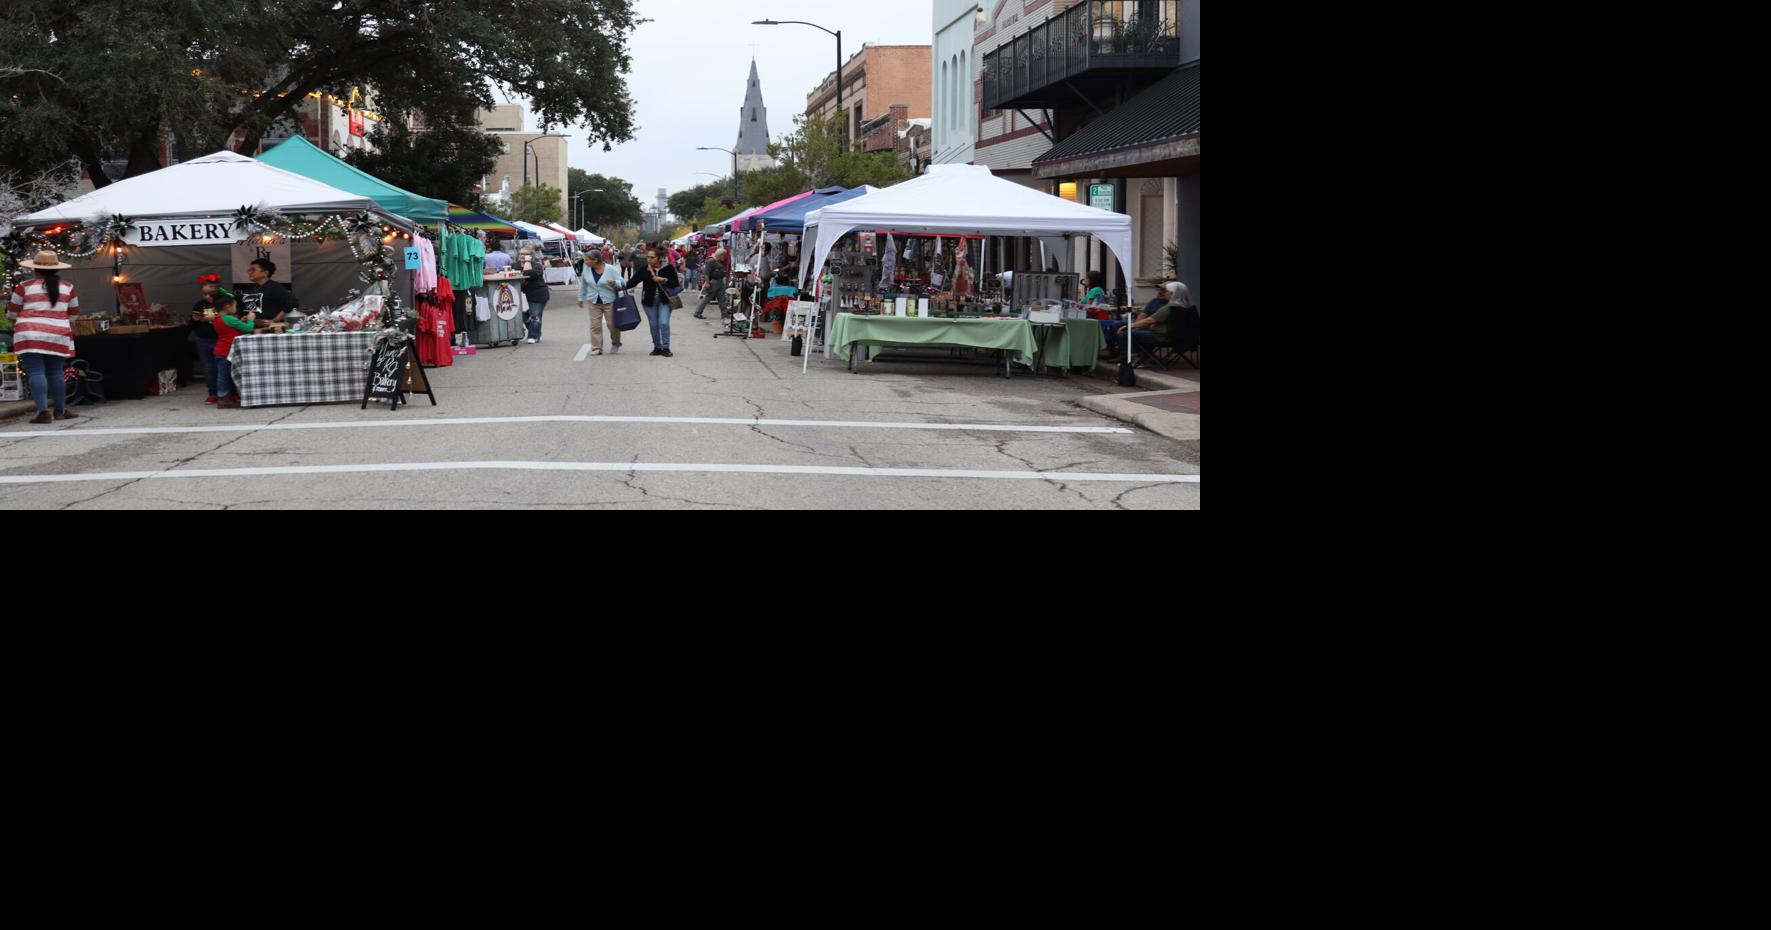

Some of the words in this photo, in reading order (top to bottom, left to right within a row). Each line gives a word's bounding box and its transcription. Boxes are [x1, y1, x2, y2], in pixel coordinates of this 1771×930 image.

[1092, 187, 1097, 195] 2
[139, 222, 233, 242] BAKERY
[407, 252, 419, 261] 73
